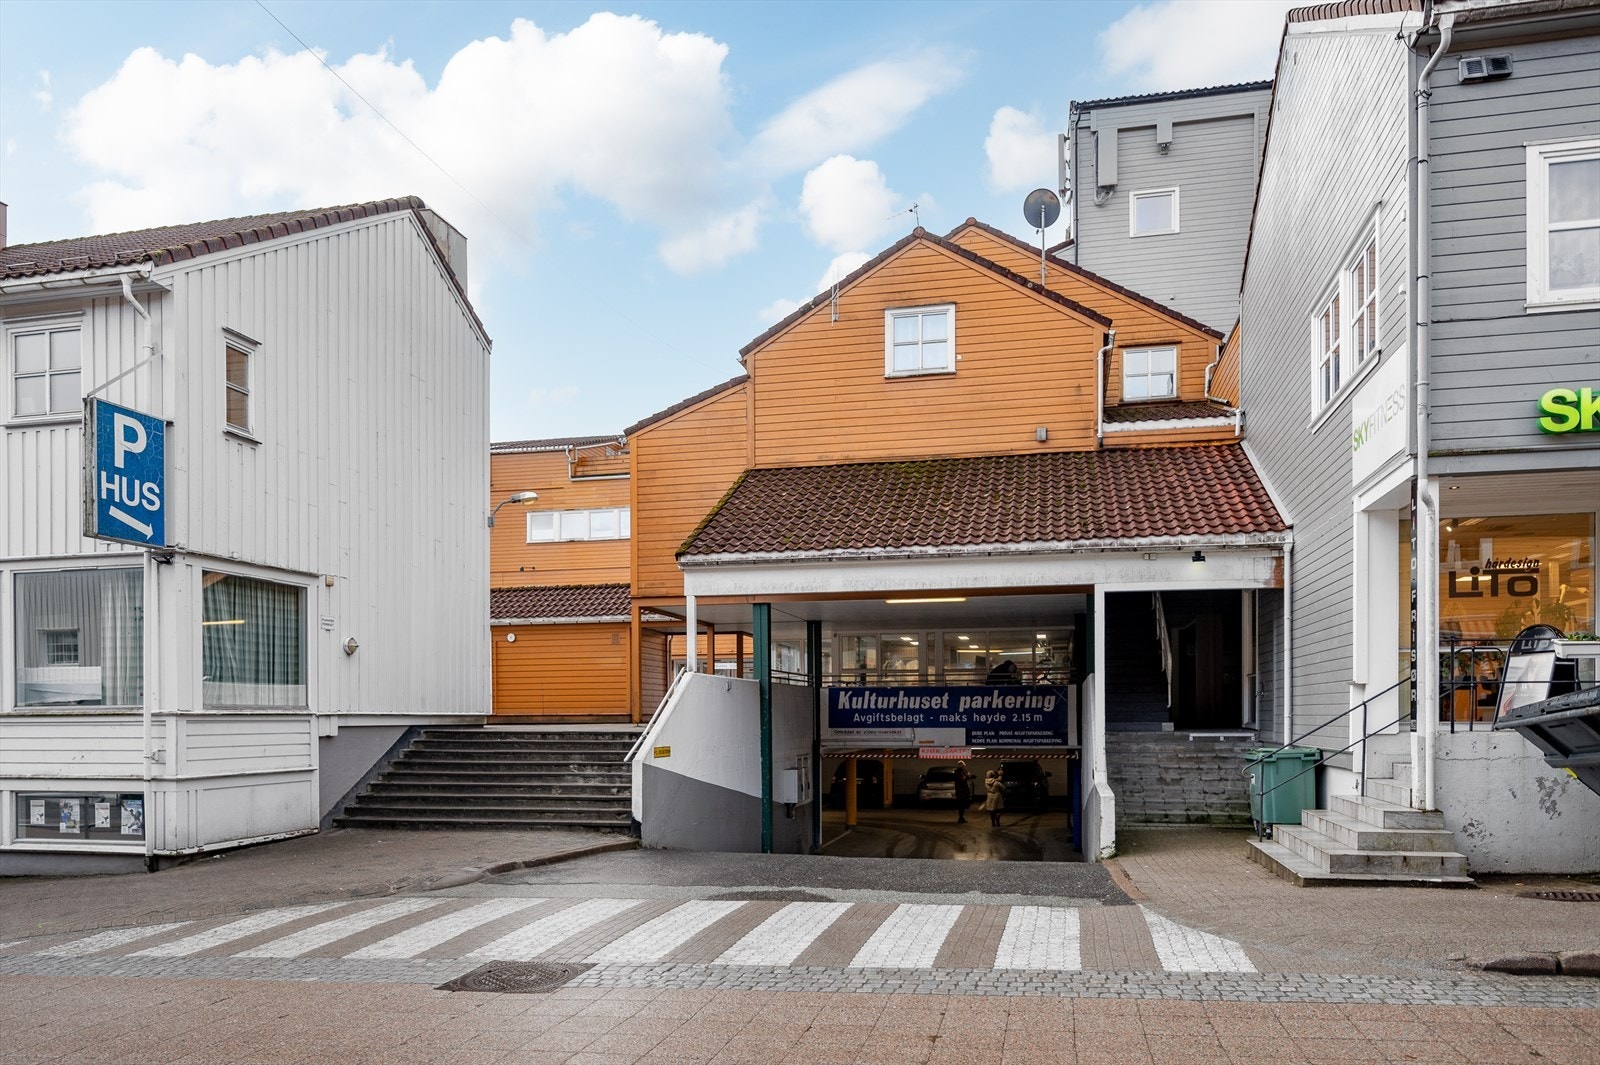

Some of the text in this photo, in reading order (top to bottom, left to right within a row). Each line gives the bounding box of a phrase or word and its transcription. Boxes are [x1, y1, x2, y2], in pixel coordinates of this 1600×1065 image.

[1353, 383, 1406, 452] SKYFITNESS
[113, 412, 148, 469] P
[100, 470, 161, 512] HUS
[838, 690, 1056, 712] Kulturhuset parkering
[853, 713, 924, 723] Avgiftsbelagt
[939, 712, 969, 722] maks
[973, 713, 1006, 724] høyde
[1012, 713, 1032, 722] 2.15
[1033, 714, 1043, 722] m
